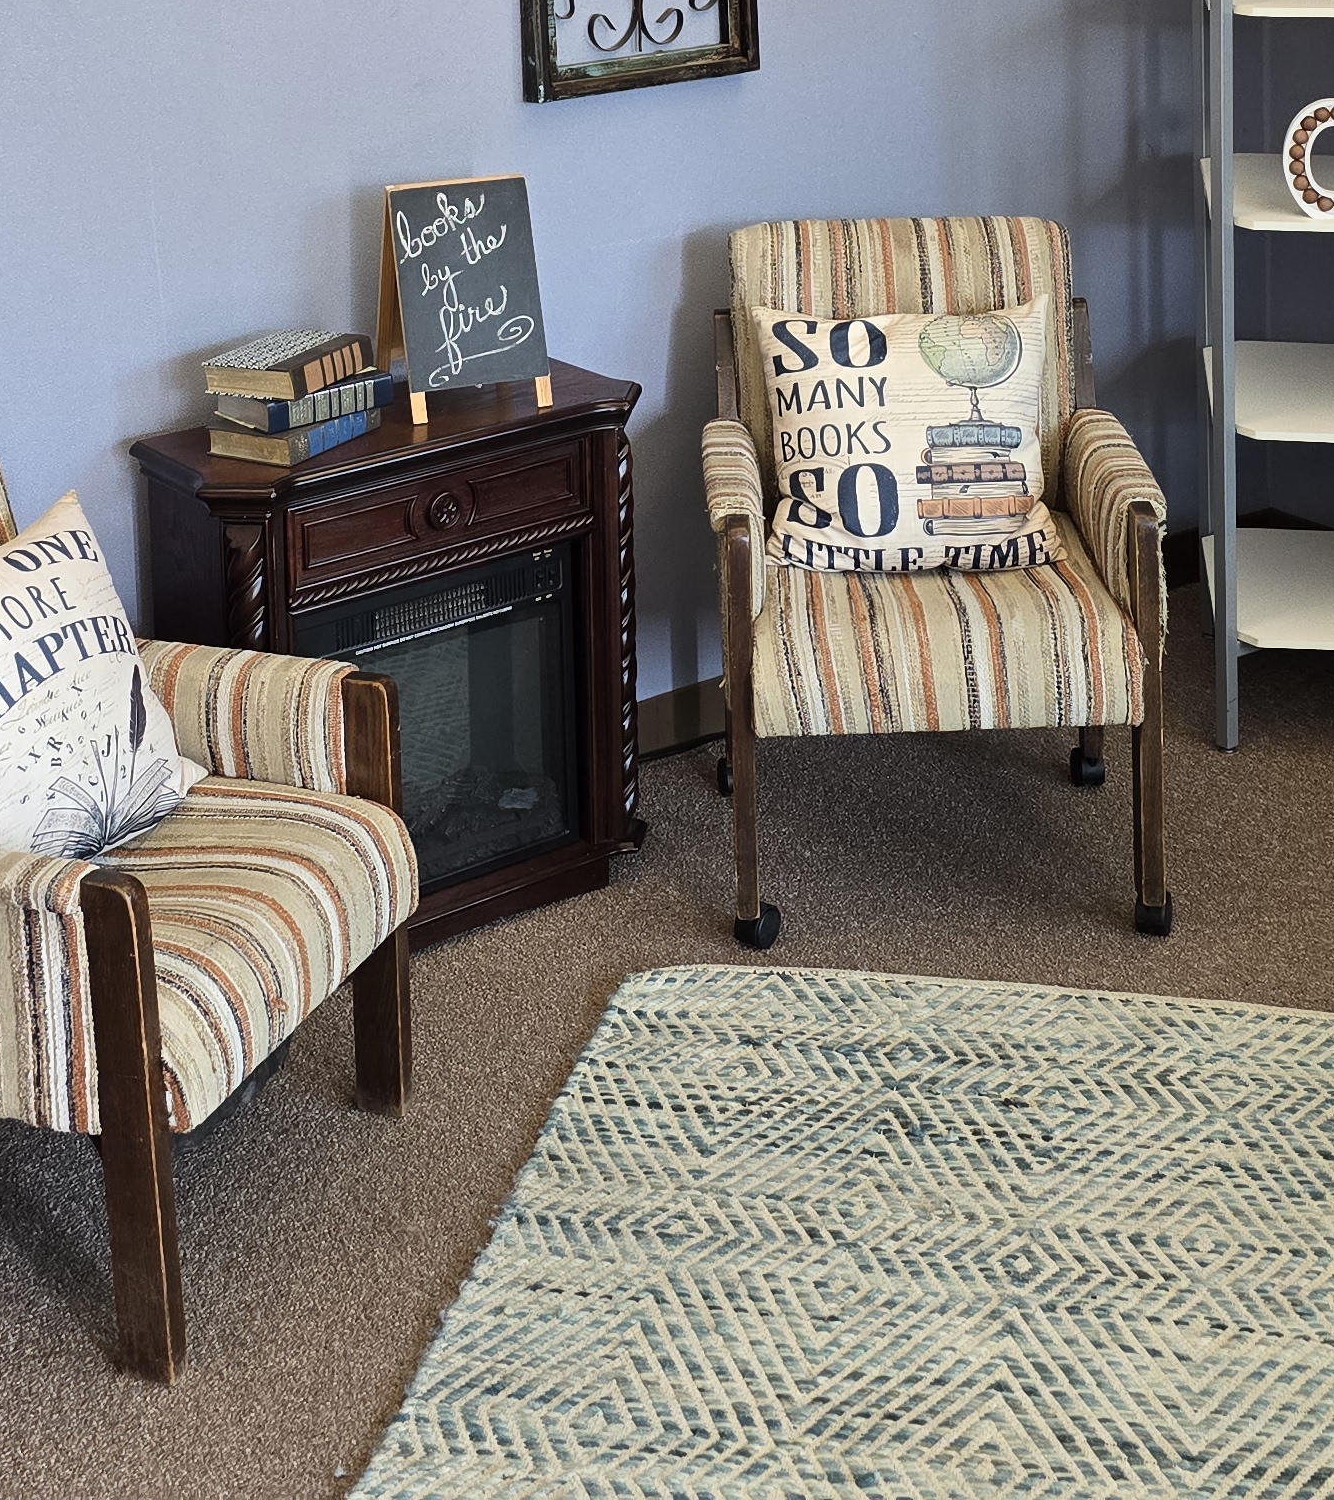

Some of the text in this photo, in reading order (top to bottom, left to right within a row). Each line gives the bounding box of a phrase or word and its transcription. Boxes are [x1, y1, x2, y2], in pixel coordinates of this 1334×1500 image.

[396, 191, 485, 264] books
[422, 224, 507, 312] by the
[435, 285, 508, 375] fire
[772, 318, 888, 377] SO
[775, 376, 888, 418] MANY
[780, 420, 892, 463] BOOKS
[786, 463, 900, 538] SO
[3, 529, 99, 573] ONE
[780, 528, 1051, 572] LITTLE TIME
